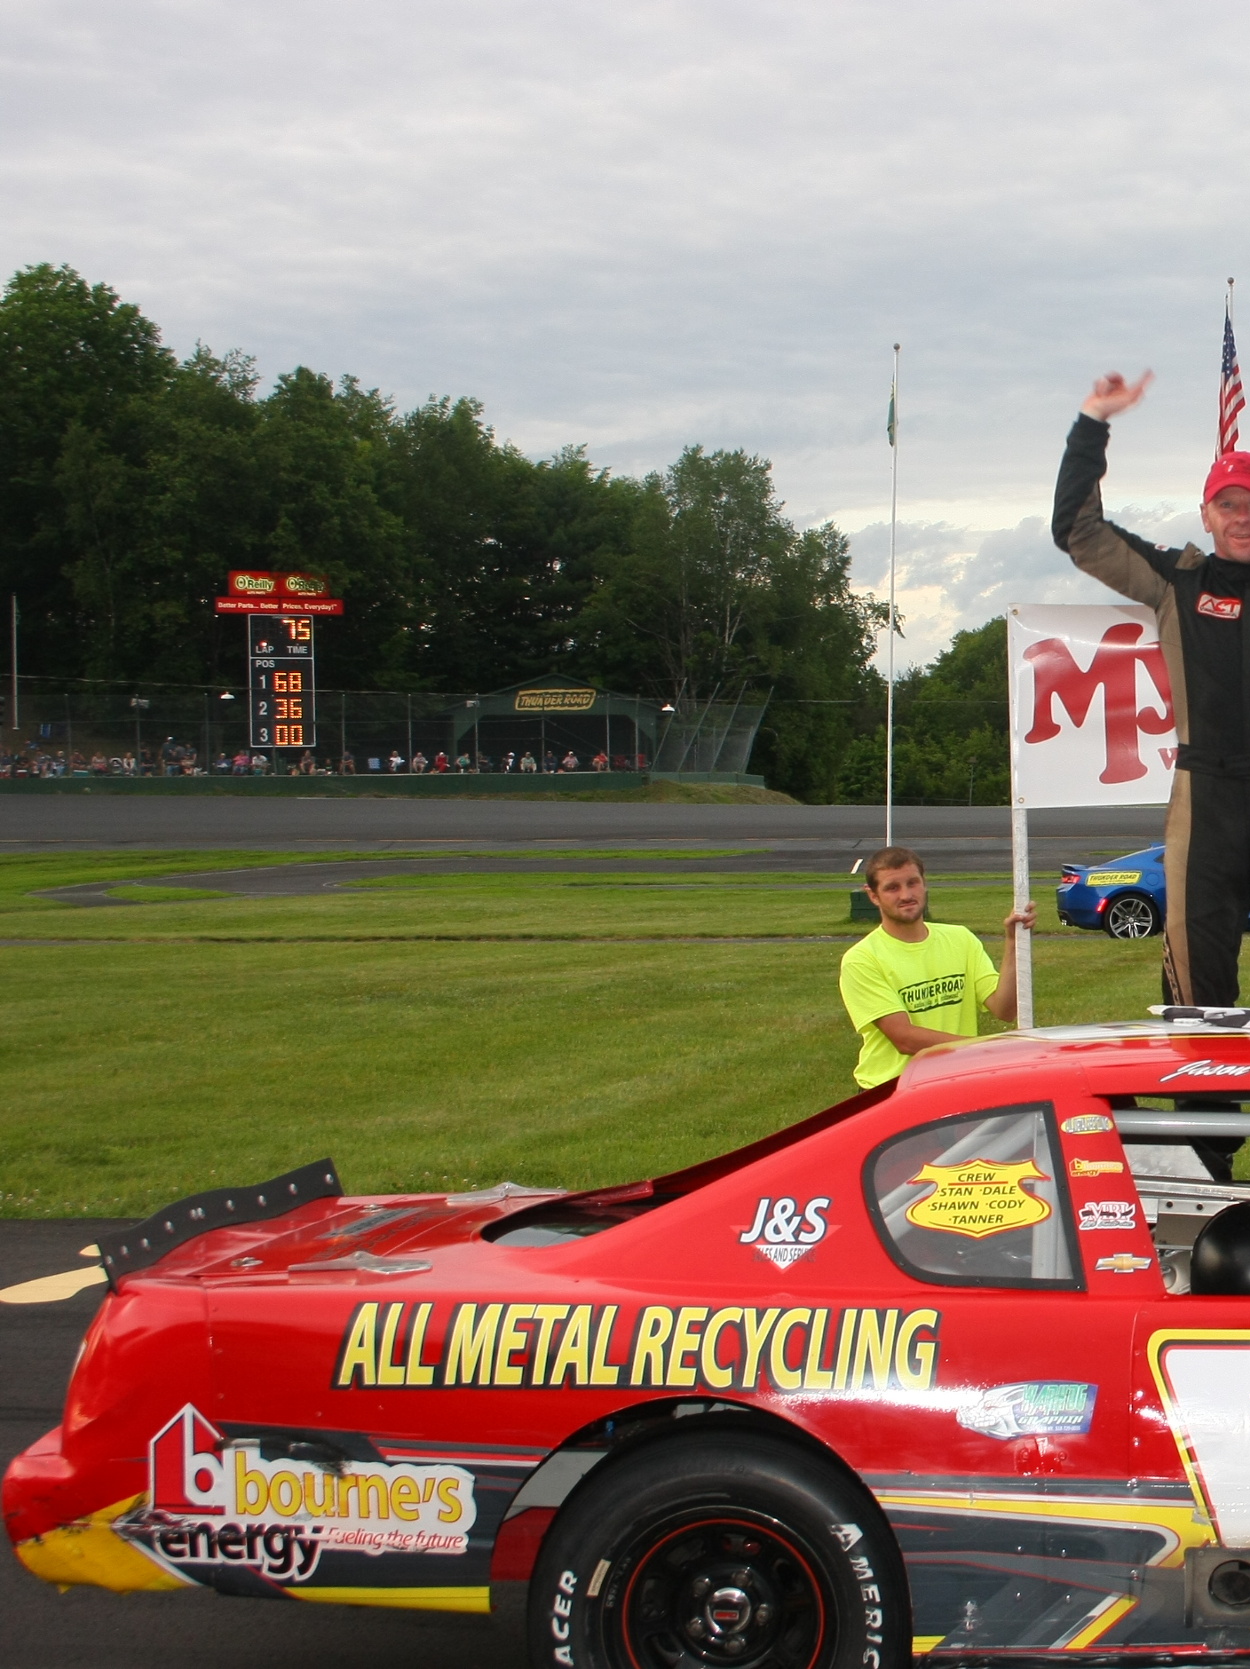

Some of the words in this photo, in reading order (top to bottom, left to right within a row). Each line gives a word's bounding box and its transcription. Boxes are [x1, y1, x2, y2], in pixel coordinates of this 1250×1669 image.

[235, 575, 274, 591] O'Reilly
[282, 619, 310, 640] 75
[256, 660, 275, 668] POS
[260, 675, 266, 689] 1
[274, 672, 302, 692] 68
[259, 701, 267, 715] 2
[275, 699, 302, 718] 36
[520, 694, 563, 706] THUNDER
[563, 693, 591, 704] ROAD
[260, 728, 268, 742] 3
[275, 725, 303, 745] 00
[901, 983, 941, 1003] THUNER
[958, 1172, 996, 1182] CREW
[939, 1187, 974, 1197] STAN
[982, 1185, 1017, 1195] DALE
[930, 1201, 979, 1211] SHAWN
[988, 1199, 1026, 1209] CODY
[739, 1197, 830, 1243] J&S
[952, 1214, 1004, 1224] TANNER
[773, 1247, 788, 1262] AND
[338, 1302, 436, 1386] ALL
[443, 1302, 621, 1387] METAL
[633, 1305, 939, 1391] RECYCLING
[234, 1450, 464, 1524] bourne's
[159, 1521, 325, 1577] energy
[384, 1529, 411, 1547] the
[411, 1530, 464, 1550] future
